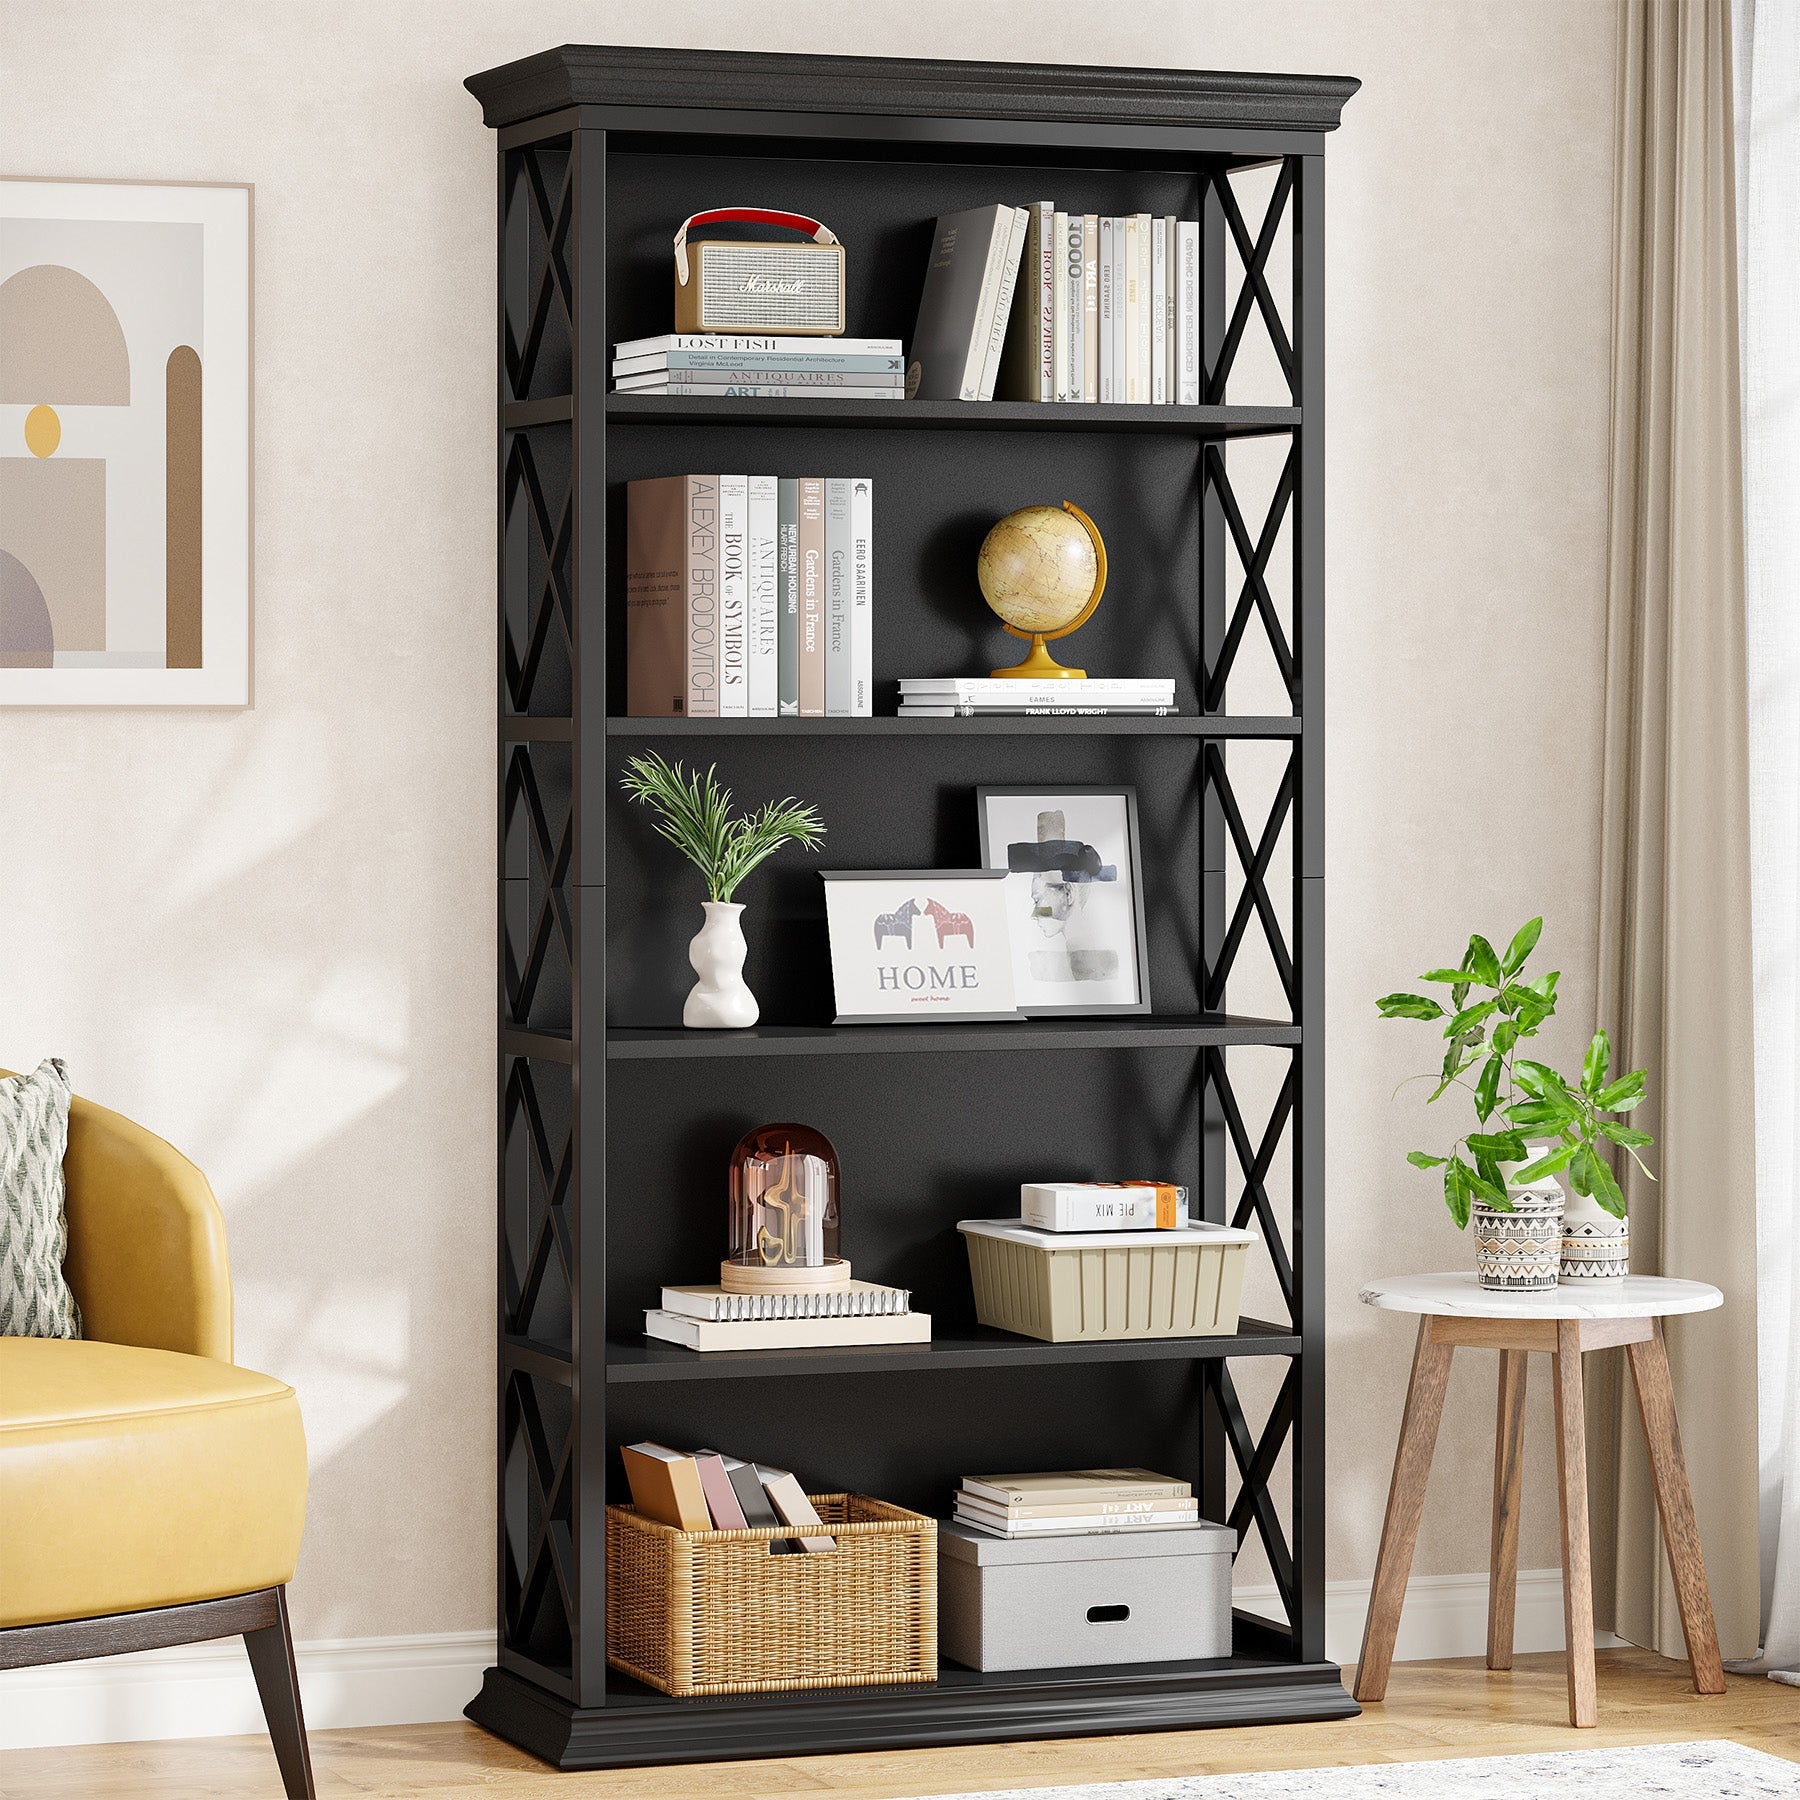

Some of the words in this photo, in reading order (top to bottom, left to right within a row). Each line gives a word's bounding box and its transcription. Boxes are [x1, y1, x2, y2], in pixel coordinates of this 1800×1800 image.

[739, 274, 806, 294] Marshall
[678, 338, 729, 349] LOST
[734, 339, 777, 350] FISH
[717, 355, 765, 363] Contemporary
[729, 372, 845, 382] ANTIQUAIRES
[723, 387, 761, 398] ART
[691, 480, 715, 562] ALEXEY
[725, 512, 733, 529] THE
[788, 524, 797, 545] NEW
[725, 532, 743, 581] BOOK
[855, 539, 866, 560] EERO
[788, 546, 797, 574] URBAN
[805, 549, 819, 597] Gardens
[832, 550, 845, 597] Gardens
[725, 585, 733, 596] OF
[788, 575, 797, 614] HOUSING
[855, 563, 866, 606] SAARINEN
[757, 537, 775, 656] ANTIQUAIRES
[805, 598, 819, 611] in
[832, 599, 845, 611] in
[691, 568, 715, 703] BRODOVITCH
[725, 600, 743, 685] SYMBOLS
[805, 613, 819, 653] France
[832, 613, 845, 653] France
[1028, 696, 1056, 704] EAMES
[1025, 708, 1051, 716] FRANK
[1051, 708, 1077, 716] LLOYD
[1077, 708, 1109, 716] WRIGHT
[877, 965, 980, 990] HOME
[1096, 1203, 1114, 1217] MIX
[1119, 1203, 1135, 1217] PIE
[1123, 1502, 1154, 1512] ART
[1123, 1513, 1154, 1524] ART
